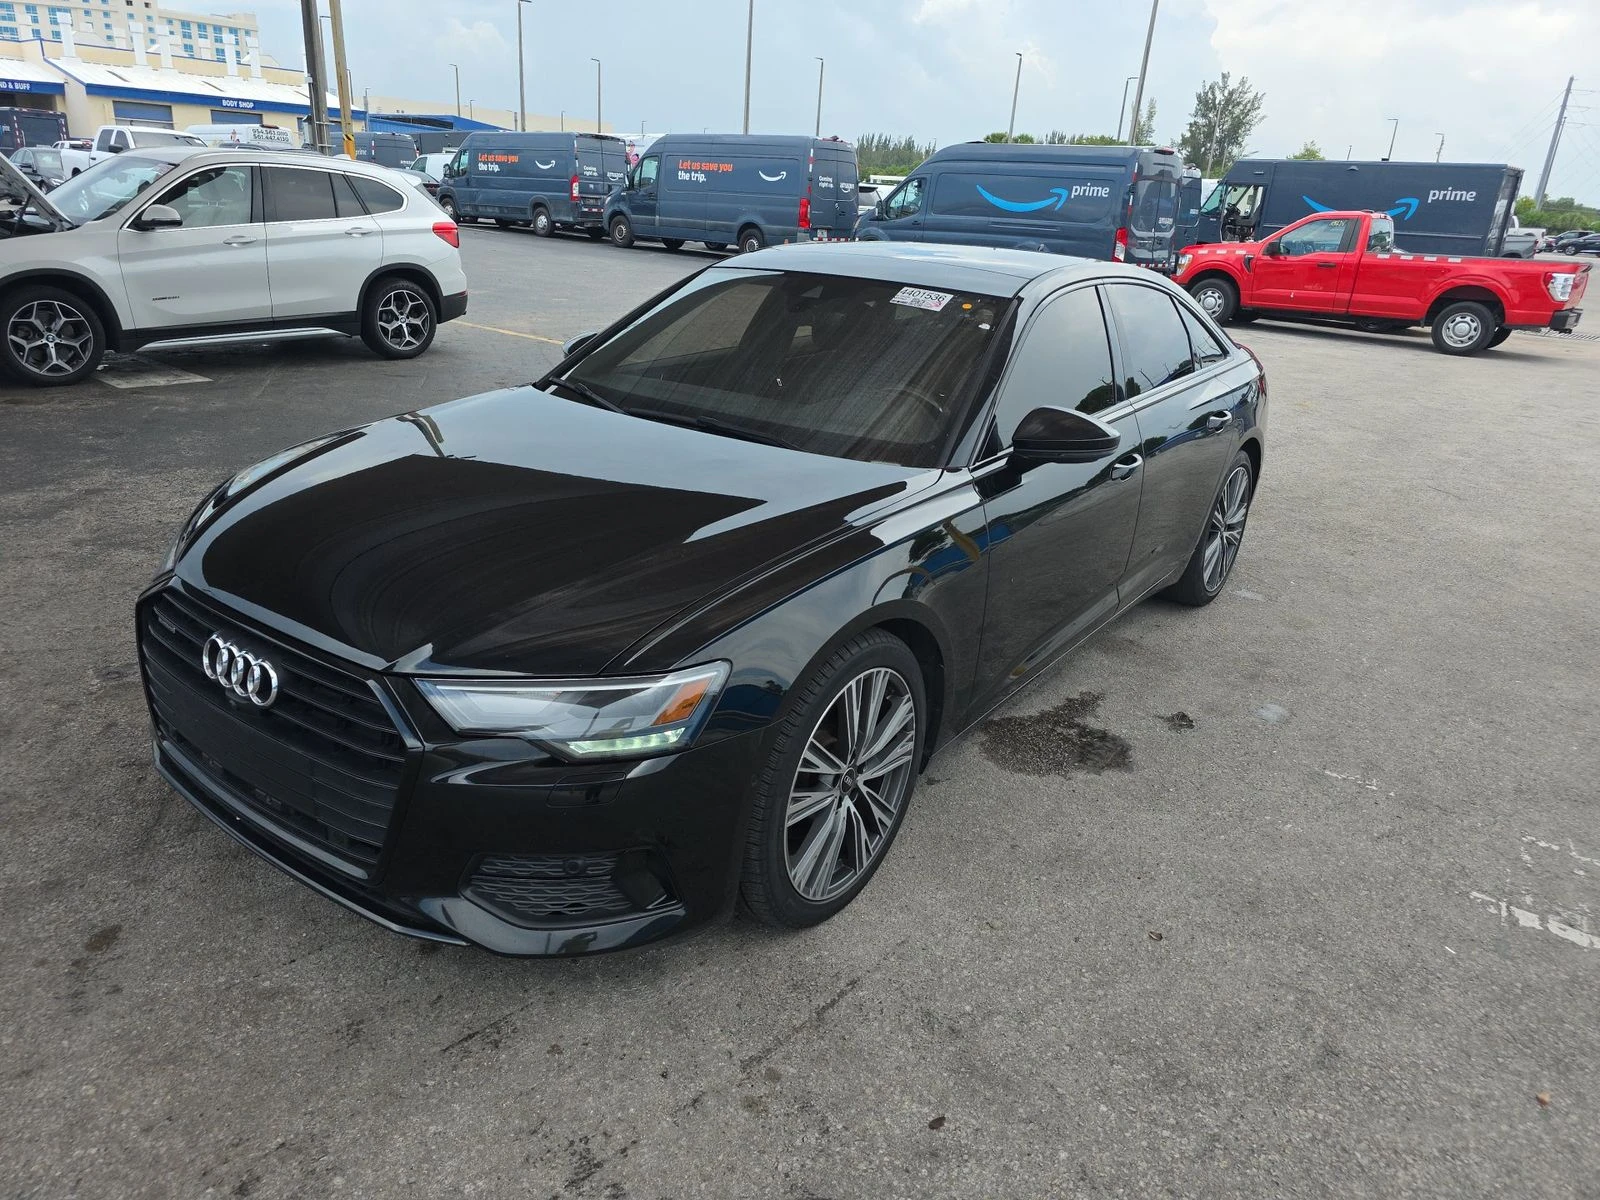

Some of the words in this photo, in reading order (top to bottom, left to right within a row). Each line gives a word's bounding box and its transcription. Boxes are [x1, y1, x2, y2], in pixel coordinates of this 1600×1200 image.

[222, 100, 238, 108] BODY
[478, 152, 488, 162] Let
[488, 154, 495, 162] us
[495, 154, 508, 163] save
[508, 155, 519, 164] you
[478, 162, 488, 171] the
[488, 162, 501, 173] trip.
[679, 160, 691, 170] Let
[691, 162, 701, 170] us
[701, 162, 719, 171] save
[719, 163, 733, 173] you
[678, 170, 691, 181] the
[691, 171, 707, 183] trip.
[1071, 182, 1110, 199] prime
[1427, 186, 1477, 204] prime
[900, 289, 947, 302] 4401536
